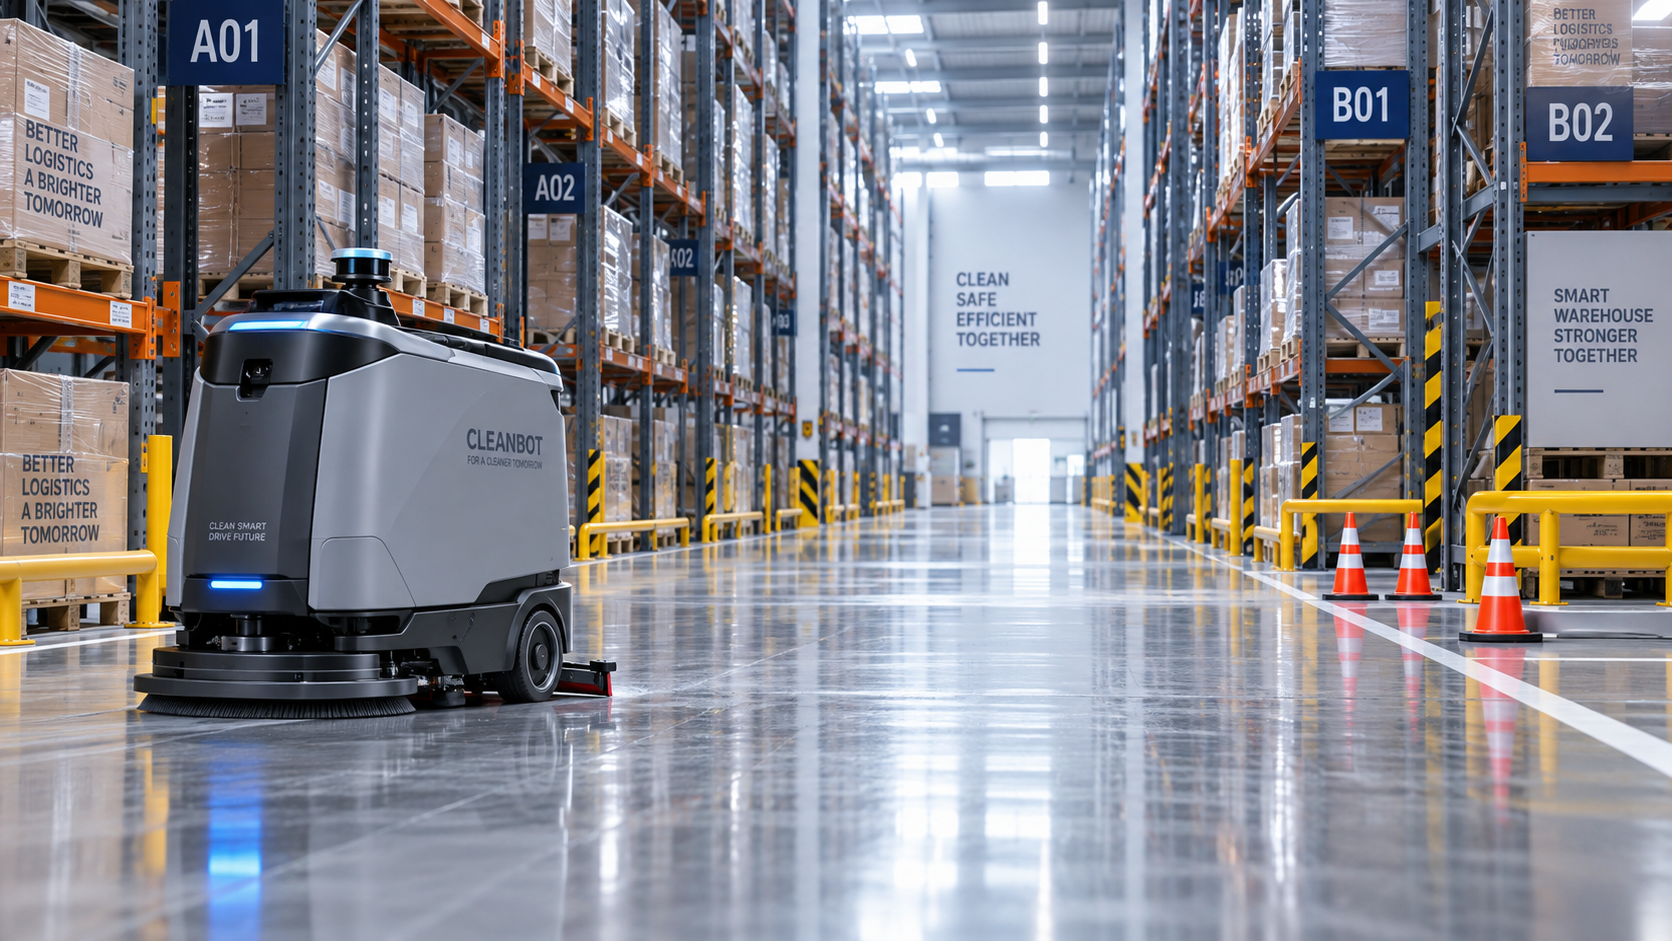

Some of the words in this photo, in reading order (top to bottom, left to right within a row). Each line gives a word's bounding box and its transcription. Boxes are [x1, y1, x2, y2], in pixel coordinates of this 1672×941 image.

[1553, 7, 1596, 20] BETTER
[190, 18, 259, 63] A01
[1333, 86, 1389, 122] B01
[1549, 102, 1613, 142] B02
[26, 119, 78, 153] BETTER
[25, 143, 94, 180] LOGISTICS
[24, 168, 34, 188] A
[38, 171, 101, 205] BRIGHTER
[534, 174, 575, 201] A02
[24, 191, 103, 228] TOMORROW
[956, 272, 1009, 287] CLEAN
[956, 292, 997, 307] SAFE
[1554, 288, 1610, 303] SMART
[956, 312, 1037, 327] EFFICIENT
[1554, 308, 1654, 323] WAREHOUSE
[956, 332, 1041, 347] TOGETHER
[1554, 328, 1638, 343] STRONGER
[1554, 348, 1638, 363] TOGETHER
[466, 428, 543, 455] CLEANBOT
[22, 454, 75, 473] BETTER
[467, 455, 479, 465] FOR
[480, 456, 485, 466] A
[486, 457, 511, 467] CLEANER
[22, 478, 90, 496] LOGISTICS
[21, 502, 31, 520] A
[35, 502, 98, 520] BRIGHTER
[20, 525, 100, 544] TOMORROW
[209, 521, 235, 530] CLEAN
[237, 521, 267, 530] SMART
[208, 532, 231, 541] DRIVE
[233, 532, 266, 541] FUTURE
